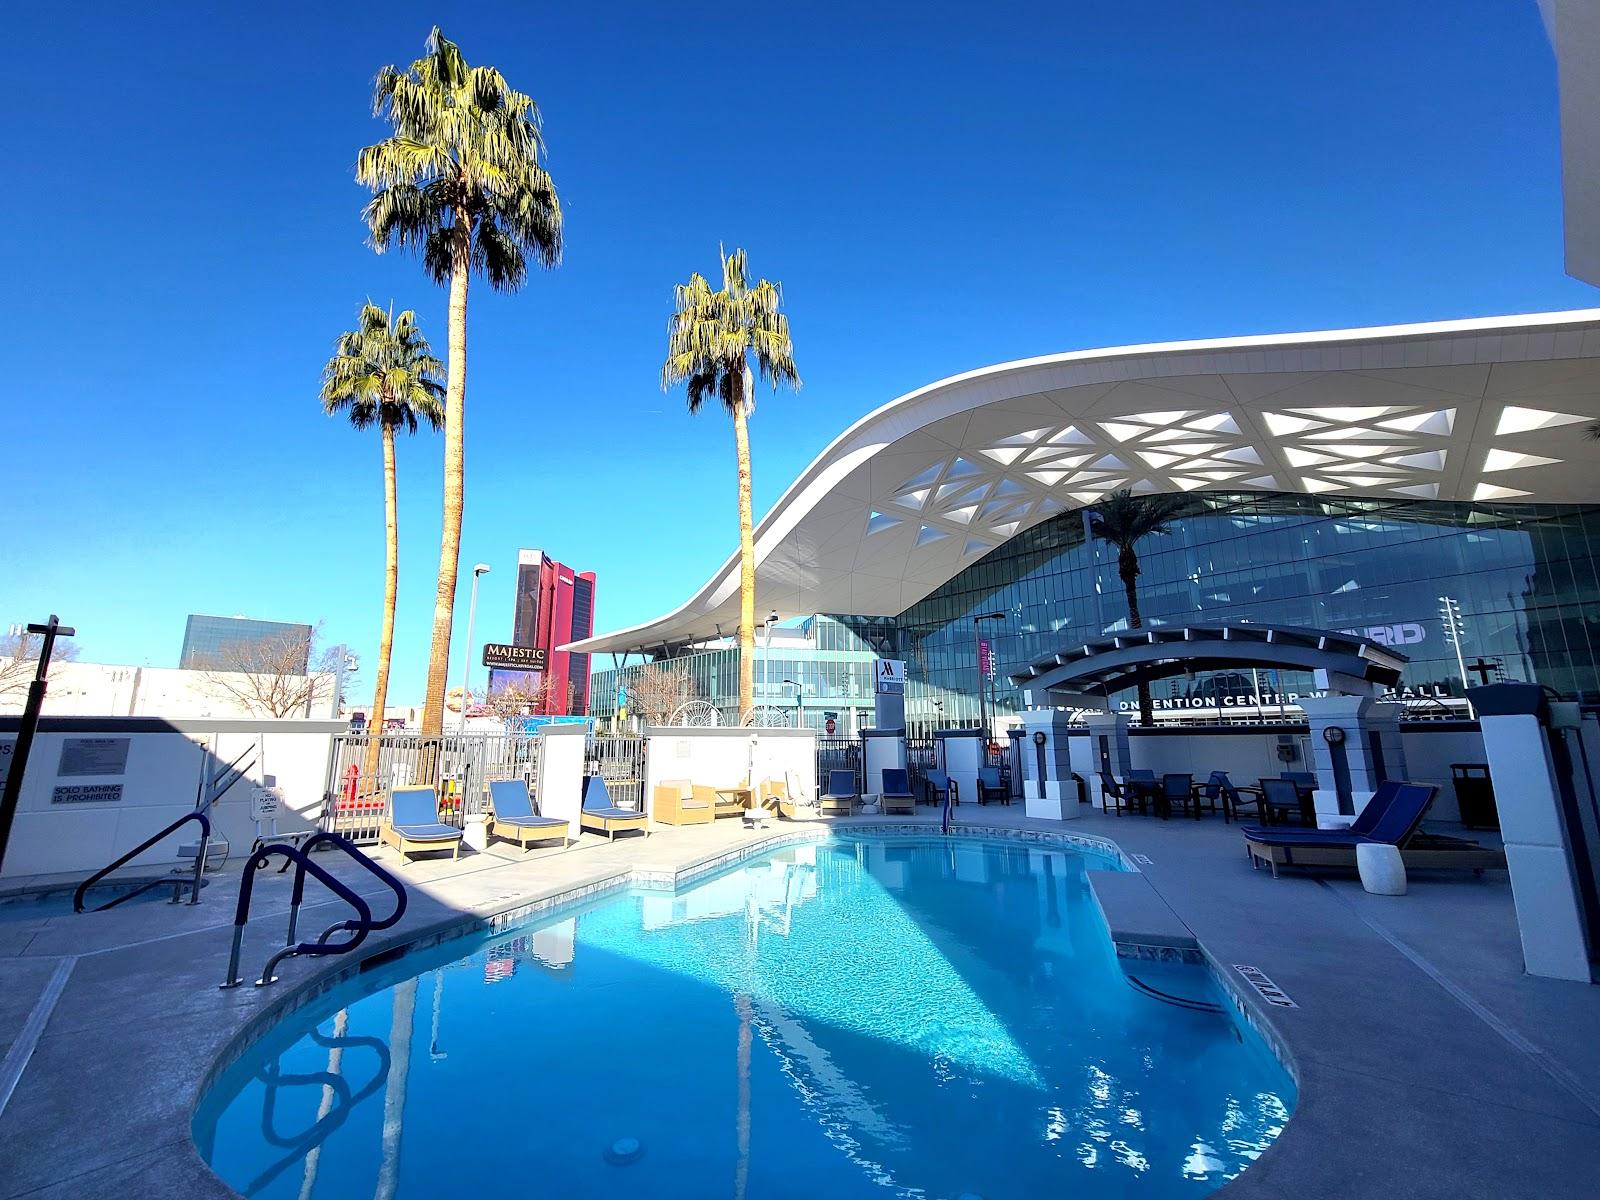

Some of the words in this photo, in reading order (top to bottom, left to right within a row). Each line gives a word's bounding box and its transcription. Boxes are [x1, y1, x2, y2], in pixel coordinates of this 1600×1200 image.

[487, 645, 545, 659] MAJESTIC
[1383, 685, 1448, 699] HALL
[55, 785, 80, 795] SOLO
[83, 784, 121, 793] BATHING
[53, 795, 63, 803] IS
[66, 791, 120, 802] PROHIBITED
